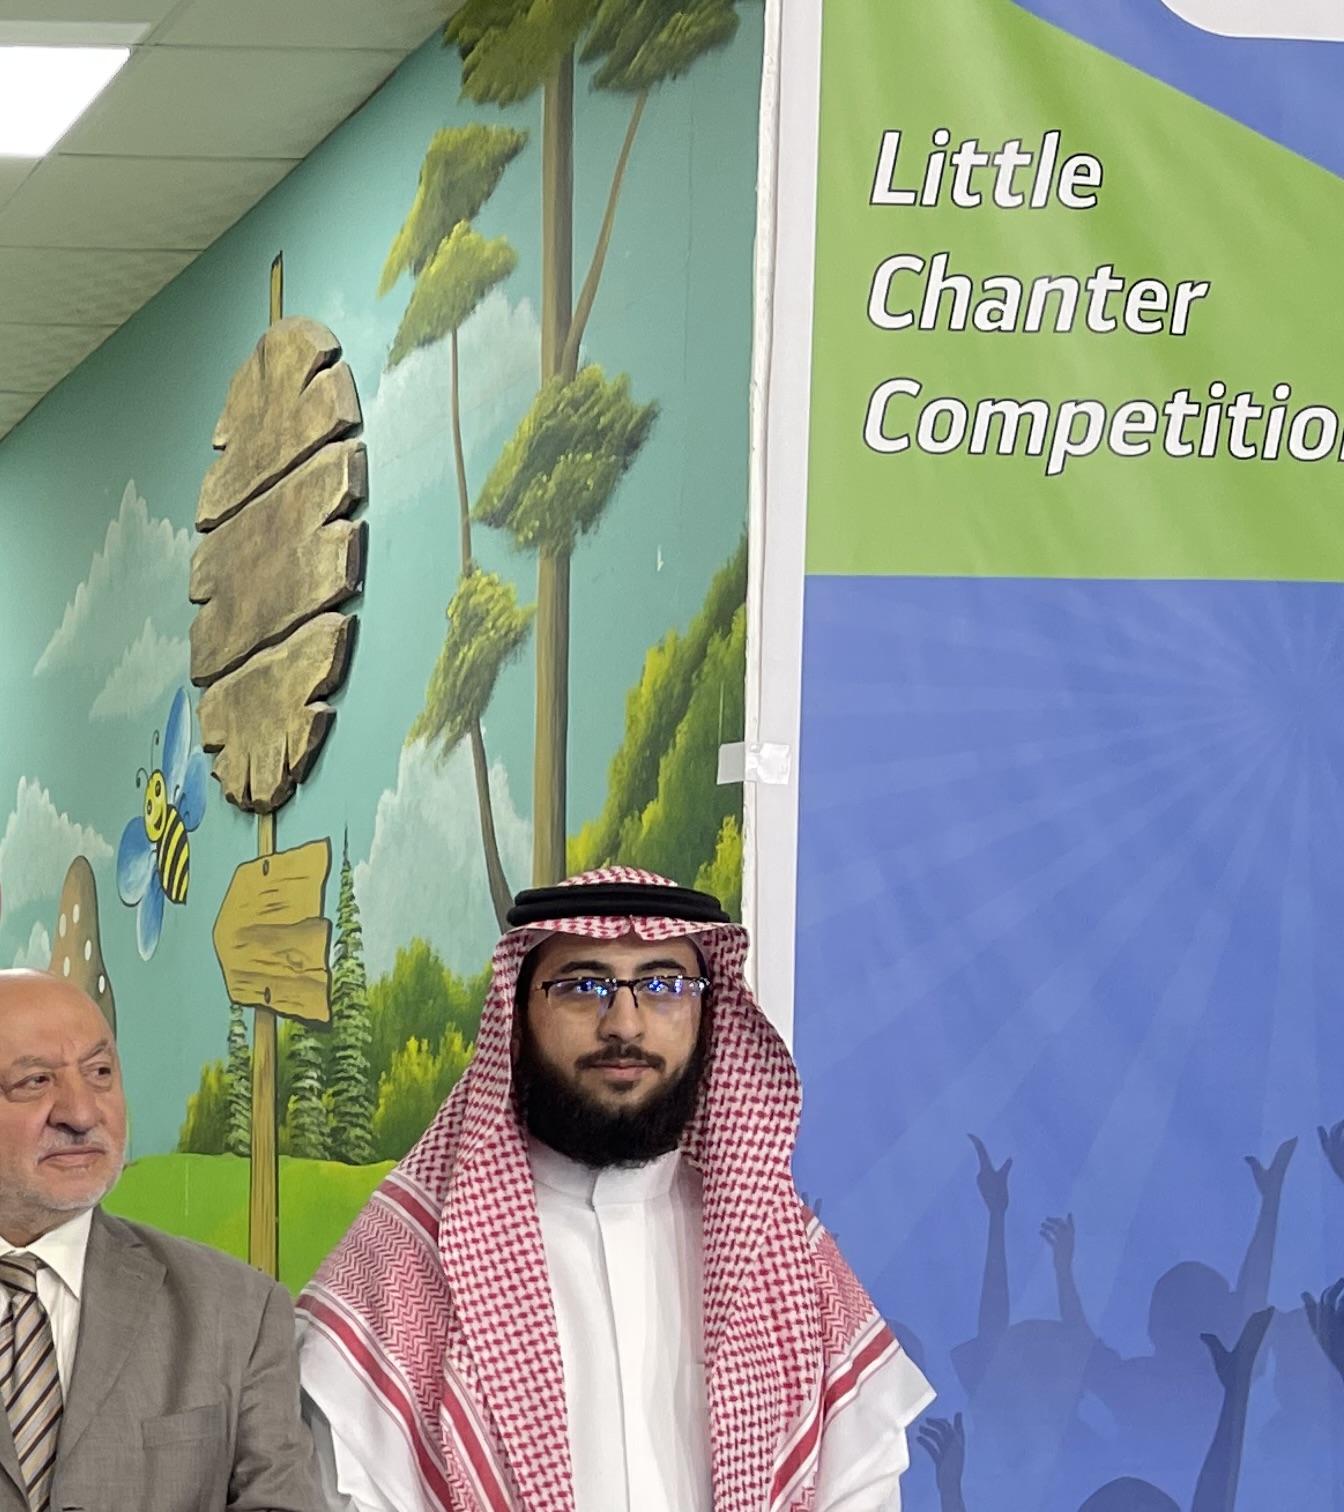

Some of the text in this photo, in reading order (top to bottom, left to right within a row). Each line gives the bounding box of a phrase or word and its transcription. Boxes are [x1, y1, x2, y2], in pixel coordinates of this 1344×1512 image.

[870, 129, 1103, 210] Little
[867, 253, 1210, 336] Chanter
[863, 378, 1344, 476] Competitio
